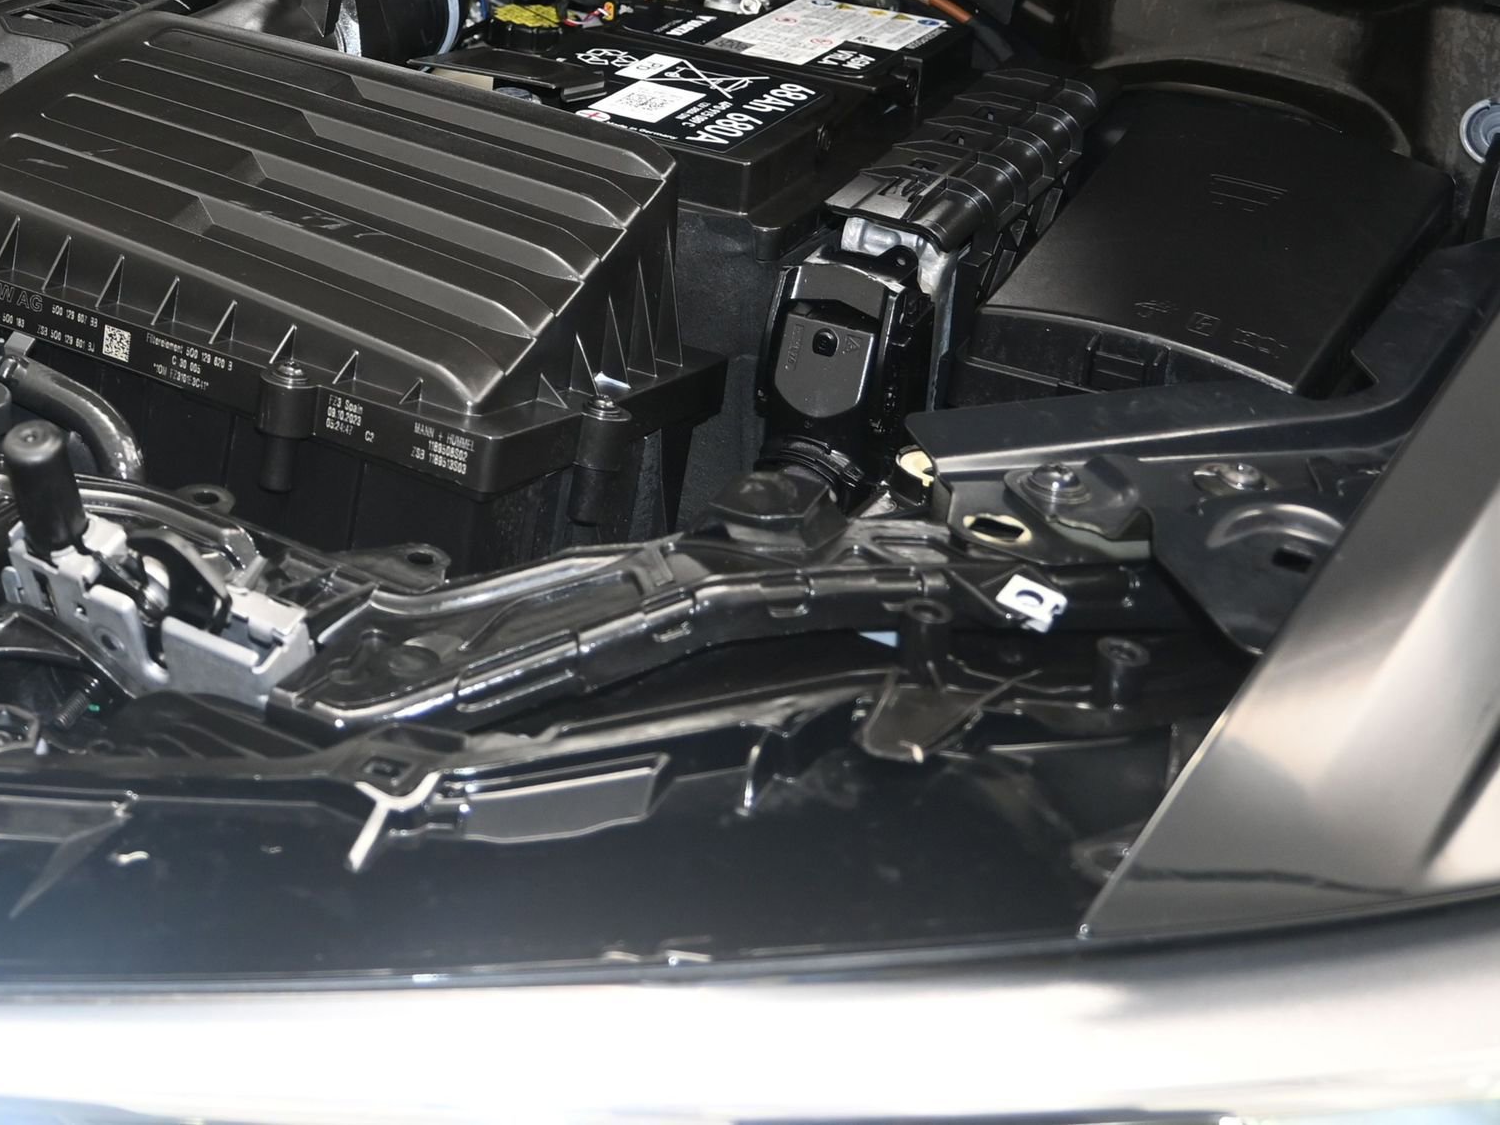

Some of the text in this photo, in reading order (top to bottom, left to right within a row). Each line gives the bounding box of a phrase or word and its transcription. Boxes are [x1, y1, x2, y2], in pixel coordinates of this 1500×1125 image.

[685, 83, 816, 144] 68Ah 680A
[638, 127, 678, 140] Germany
[16, 291, 43, 312] AG
[171, 355, 177, 365] C
[344, 398, 364, 414] Spain
[414, 422, 435, 439] MANN
[446, 432, 475, 452] HUMMEL
